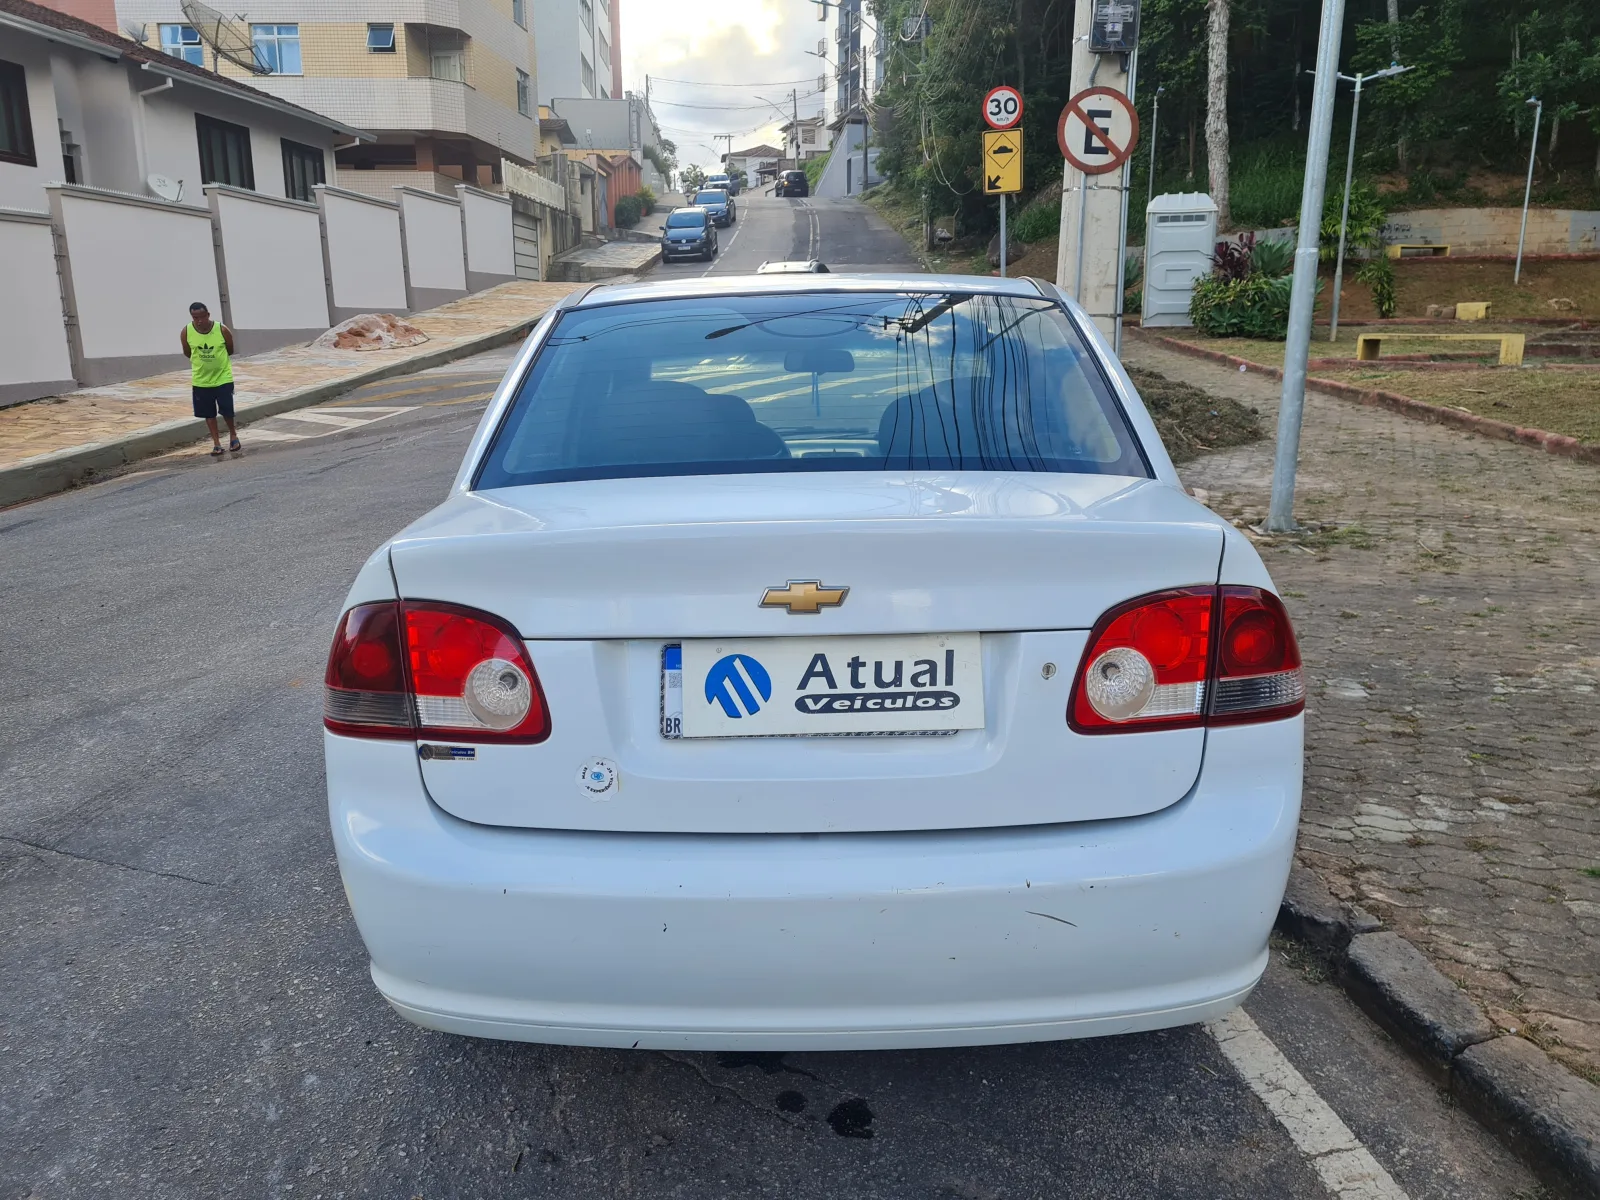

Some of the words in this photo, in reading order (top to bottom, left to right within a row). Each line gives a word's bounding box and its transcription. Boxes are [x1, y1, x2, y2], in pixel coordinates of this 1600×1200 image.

[989, 97, 1018, 116] 30
[1084, 110, 1112, 155] E
[796, 649, 955, 691] Atual
[804, 695, 955, 711] Veículos
[665, 717, 681, 734] BR
